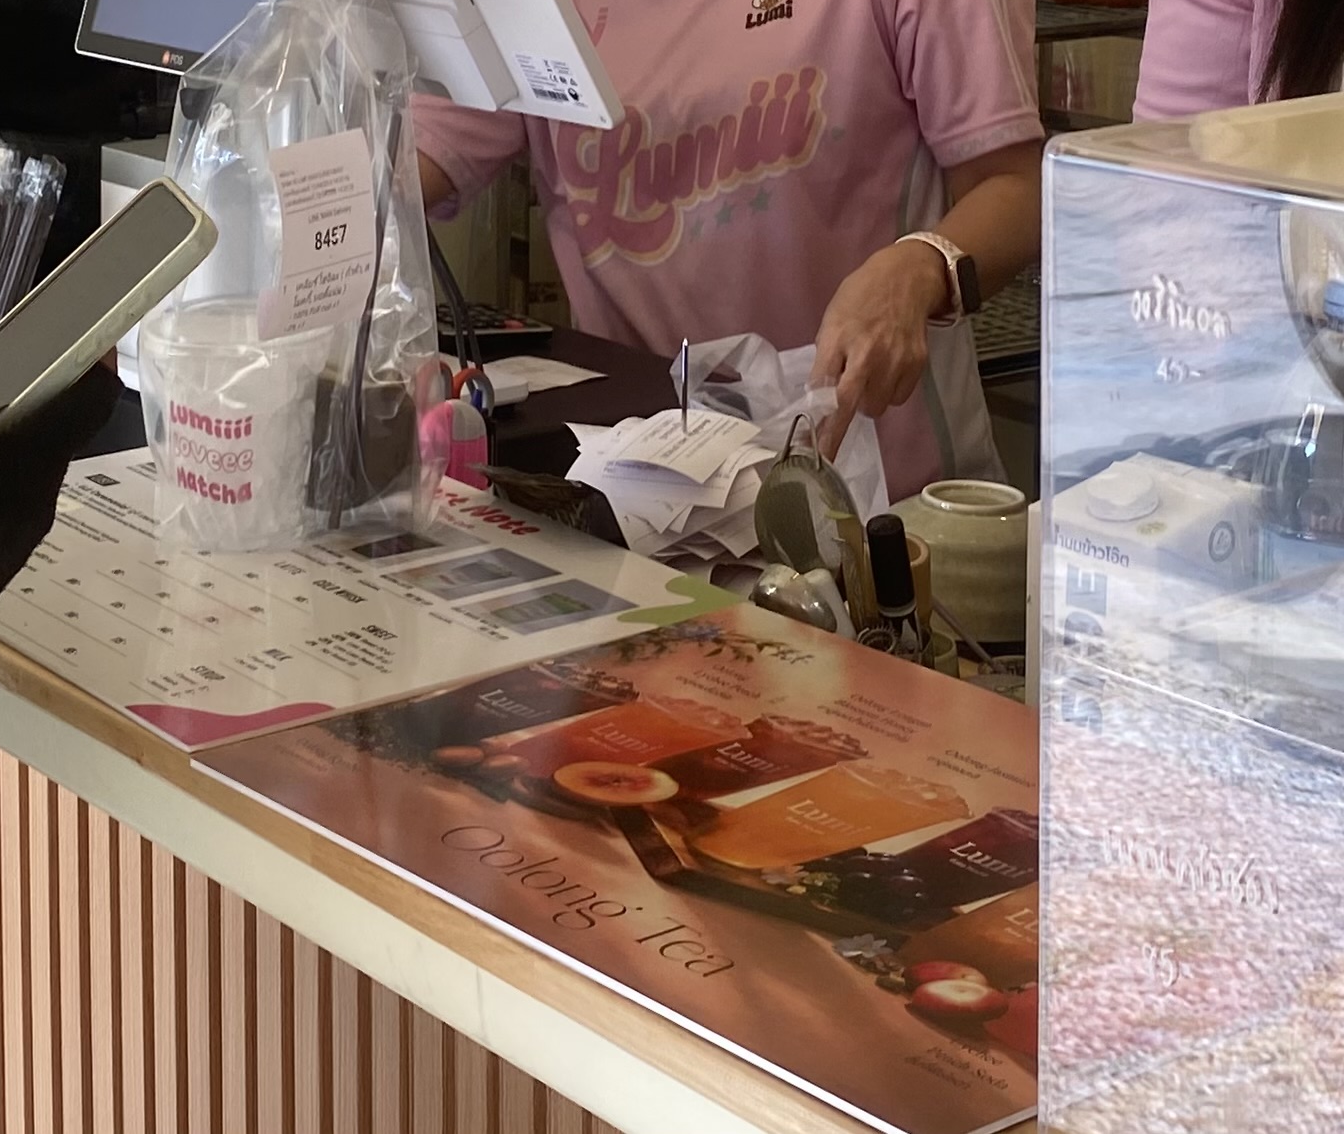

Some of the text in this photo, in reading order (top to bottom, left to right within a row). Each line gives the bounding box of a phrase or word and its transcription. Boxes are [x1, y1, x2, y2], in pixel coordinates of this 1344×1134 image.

[314, 223, 348, 251] 8457
[176, 466, 253, 506] Matcha
[458, 505, 541, 536] Note
[479, 688, 552, 719] Lumi
[590, 721, 665, 754] Lumi
[948, 840, 1035, 880] Lumi
[440, 824, 736, 979] Oolong Tea
